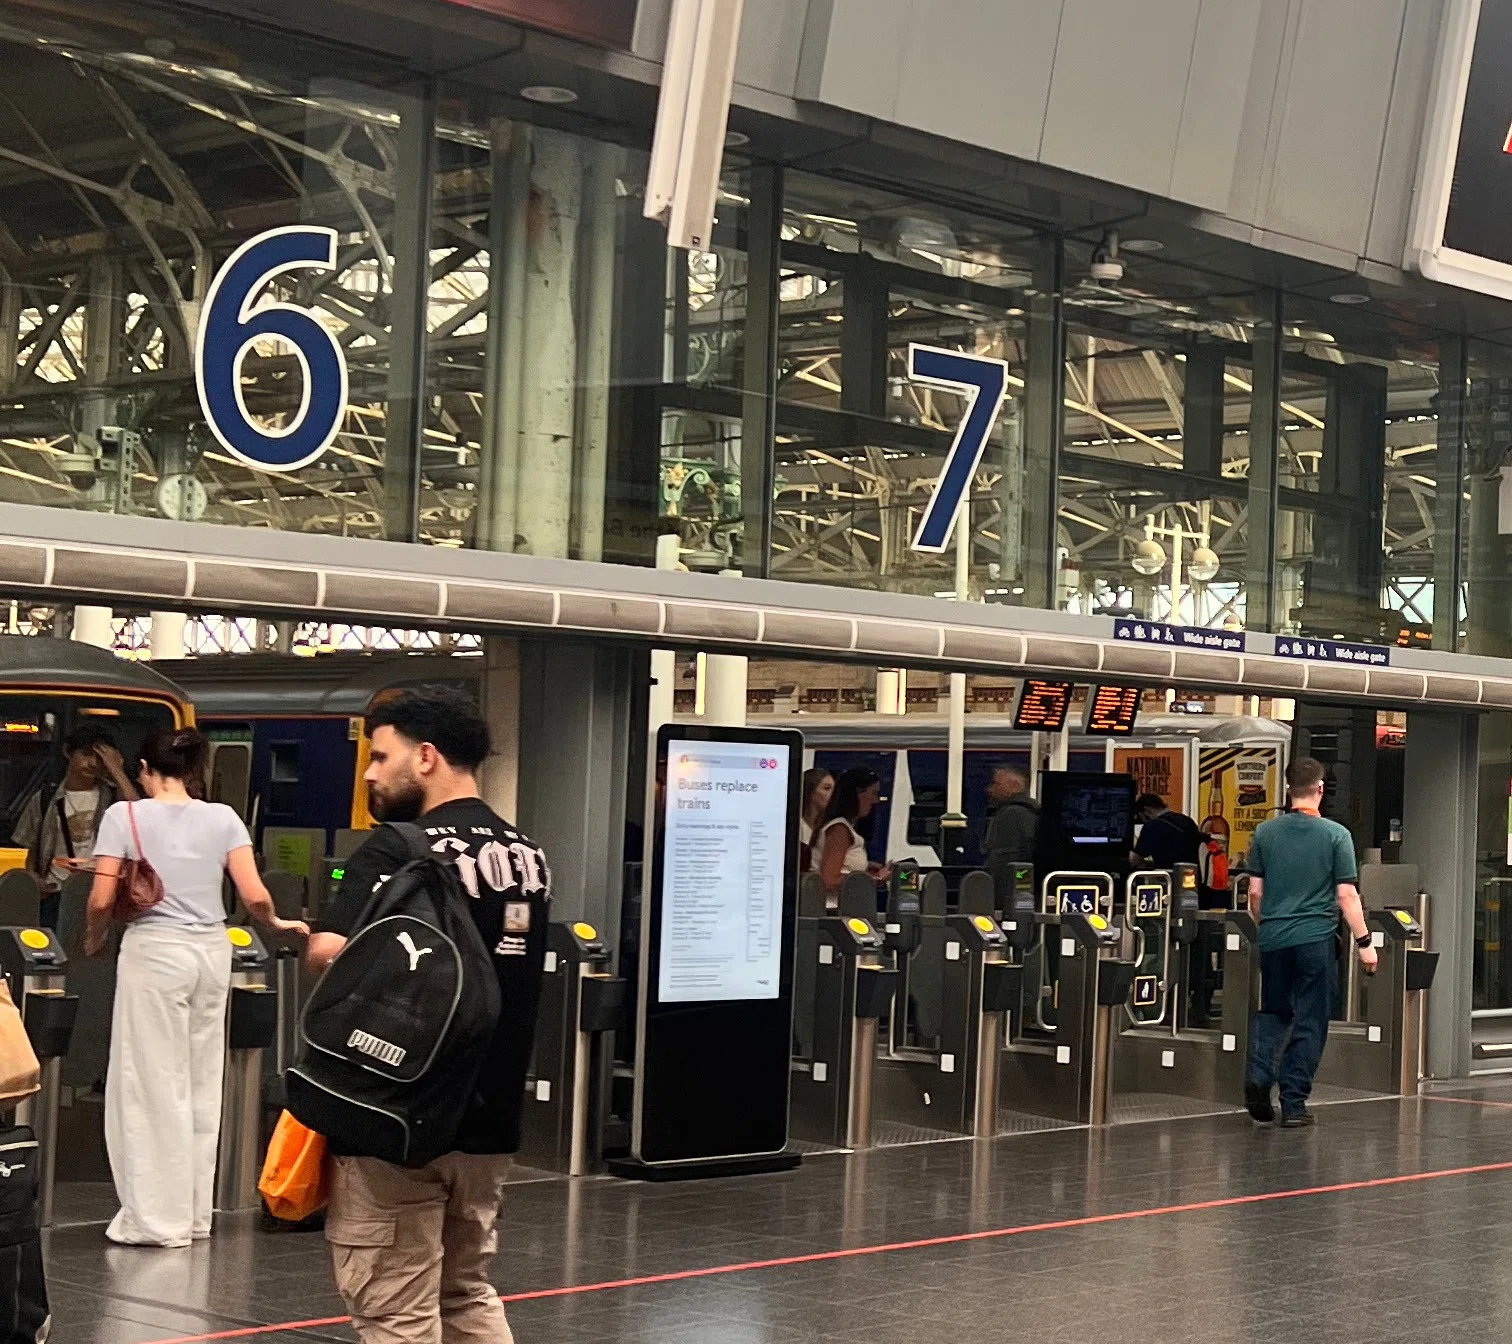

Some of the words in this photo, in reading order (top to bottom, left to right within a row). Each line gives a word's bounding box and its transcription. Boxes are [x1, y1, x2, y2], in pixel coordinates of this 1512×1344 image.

[195, 224, 349, 472] 6
[908, 342, 1009, 554] 7
[1183, 631, 1203, 645] Wide
[1223, 638, 1241, 649] gate
[1335, 647, 1353, 659] Wide
[1126, 757, 1171, 776] NATIONAL
[678, 777, 712, 791] Buses
[715, 780, 758, 794] replace
[677, 797, 711, 809] trains
[346, 1029, 407, 1067] PUMA
